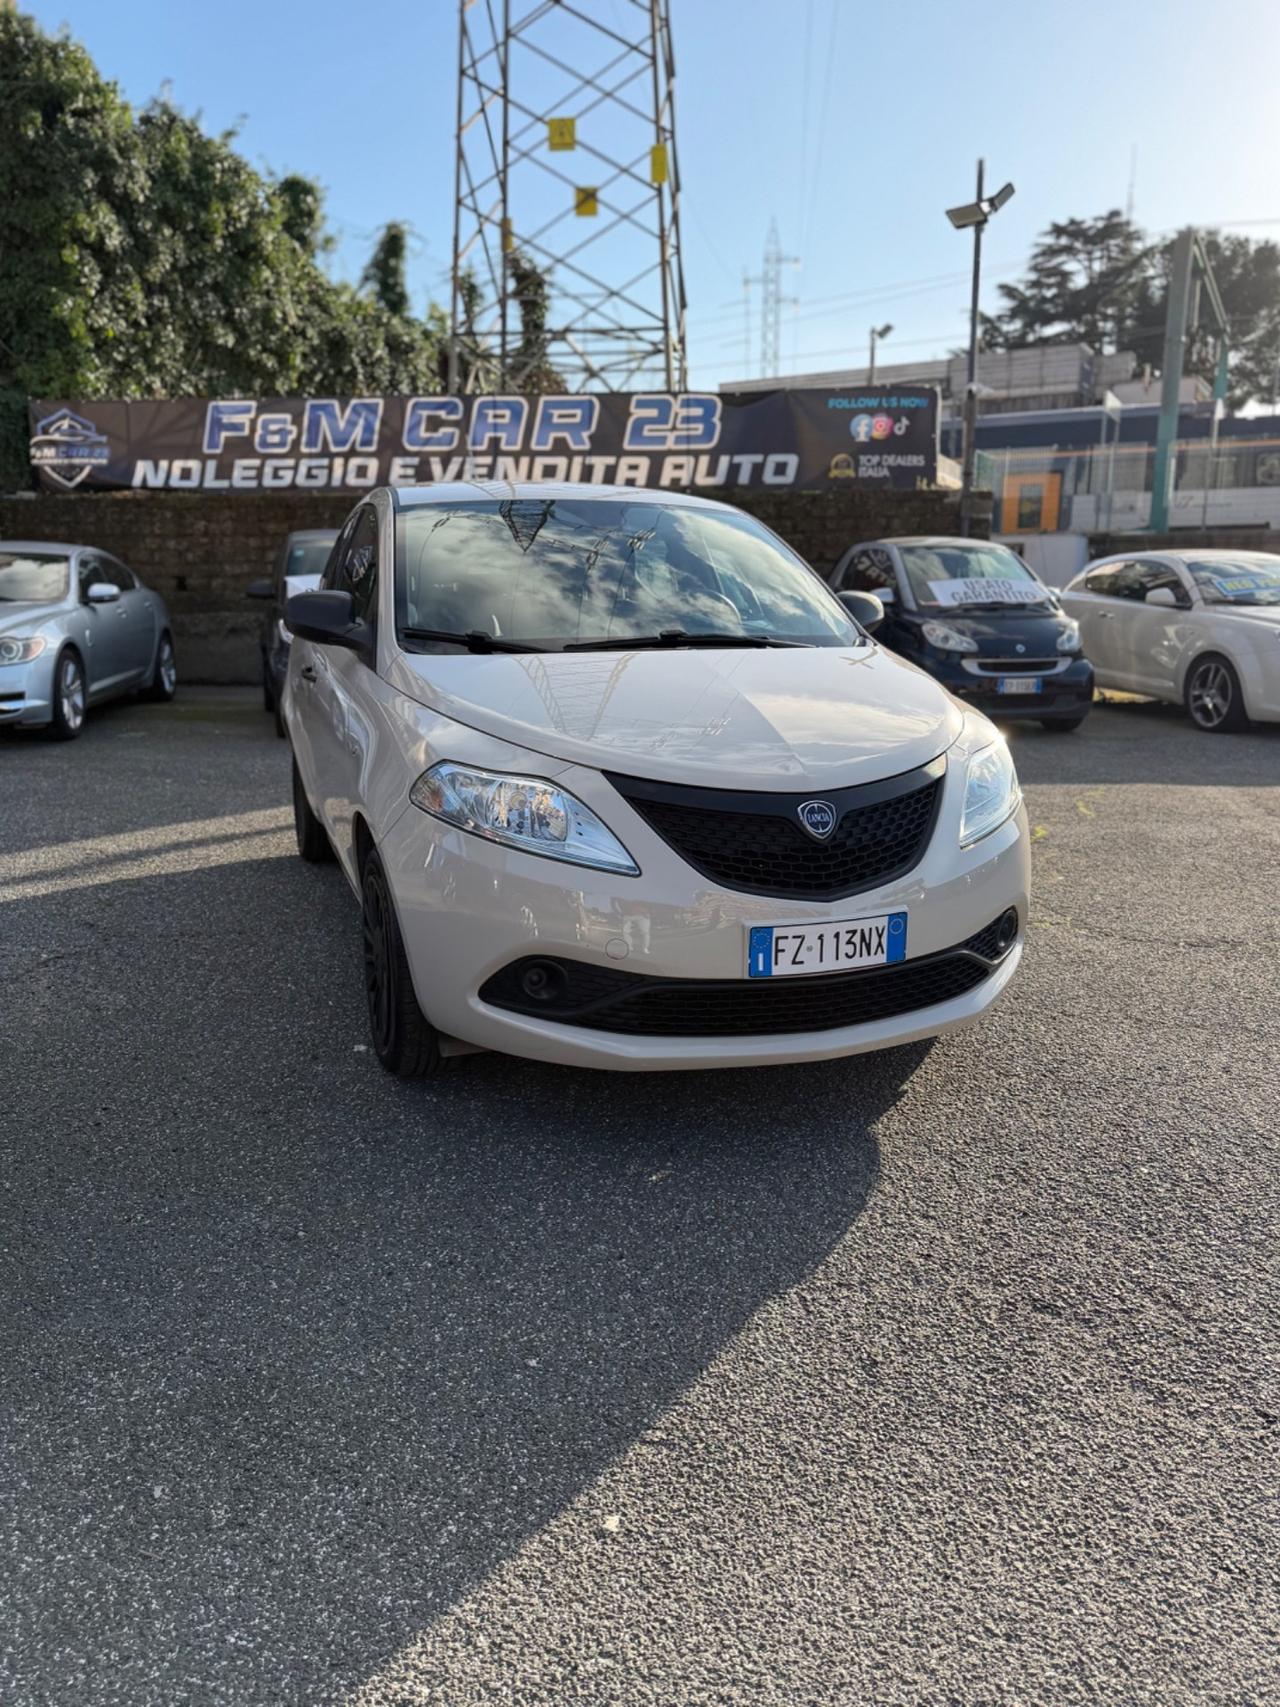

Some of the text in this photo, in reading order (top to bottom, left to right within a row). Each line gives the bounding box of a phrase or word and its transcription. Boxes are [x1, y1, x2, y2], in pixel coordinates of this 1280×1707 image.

[828, 397, 929, 409] FOLLOW US NOW
[203, 394, 722, 453] F&M CAR 23
[859, 454, 925, 466] TOP DEALERS
[131, 453, 799, 488] NOLEGGIO E VENDITA AUTO
[858, 467, 890, 477] ITALIA
[963, 580, 1014, 591] USATO
[951, 591, 1037, 602] GARANTITO
[807, 812, 830, 823] LANCIA
